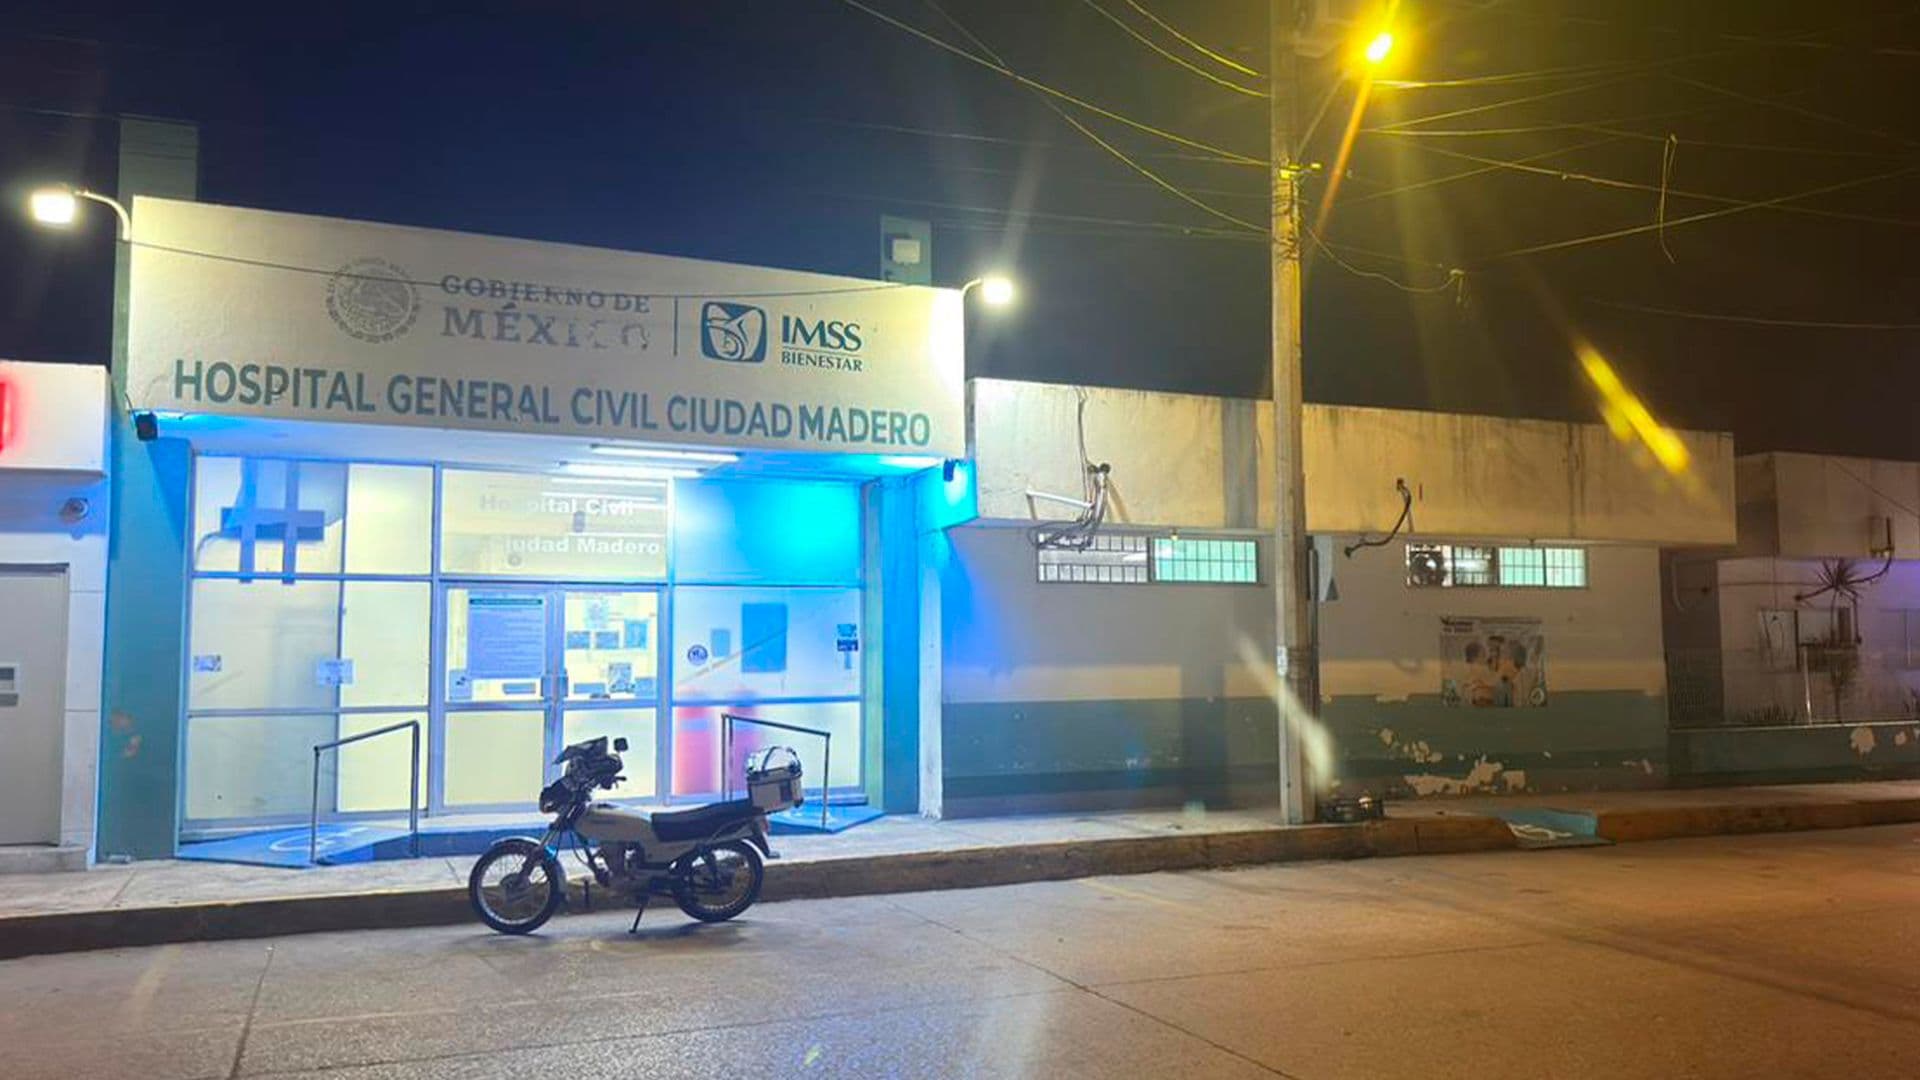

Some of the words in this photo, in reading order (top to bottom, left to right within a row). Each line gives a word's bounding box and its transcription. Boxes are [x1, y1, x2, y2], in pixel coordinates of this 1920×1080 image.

[440, 274, 606, 309] GOBIERNO
[613, 292, 650, 314] DE
[782, 315, 862, 352] IMSS
[781, 351, 863, 372] BIENESTAR
[175, 359, 376, 412] HOSPITAL
[386, 373, 560, 425] GENERAL
[570, 387, 658, 430] CIVIL
[667, 395, 793, 438] CIUDAD
[799, 404, 931, 446] MADERO
[584, 498, 634, 516] Civil
[577, 536, 660, 554] Madero
